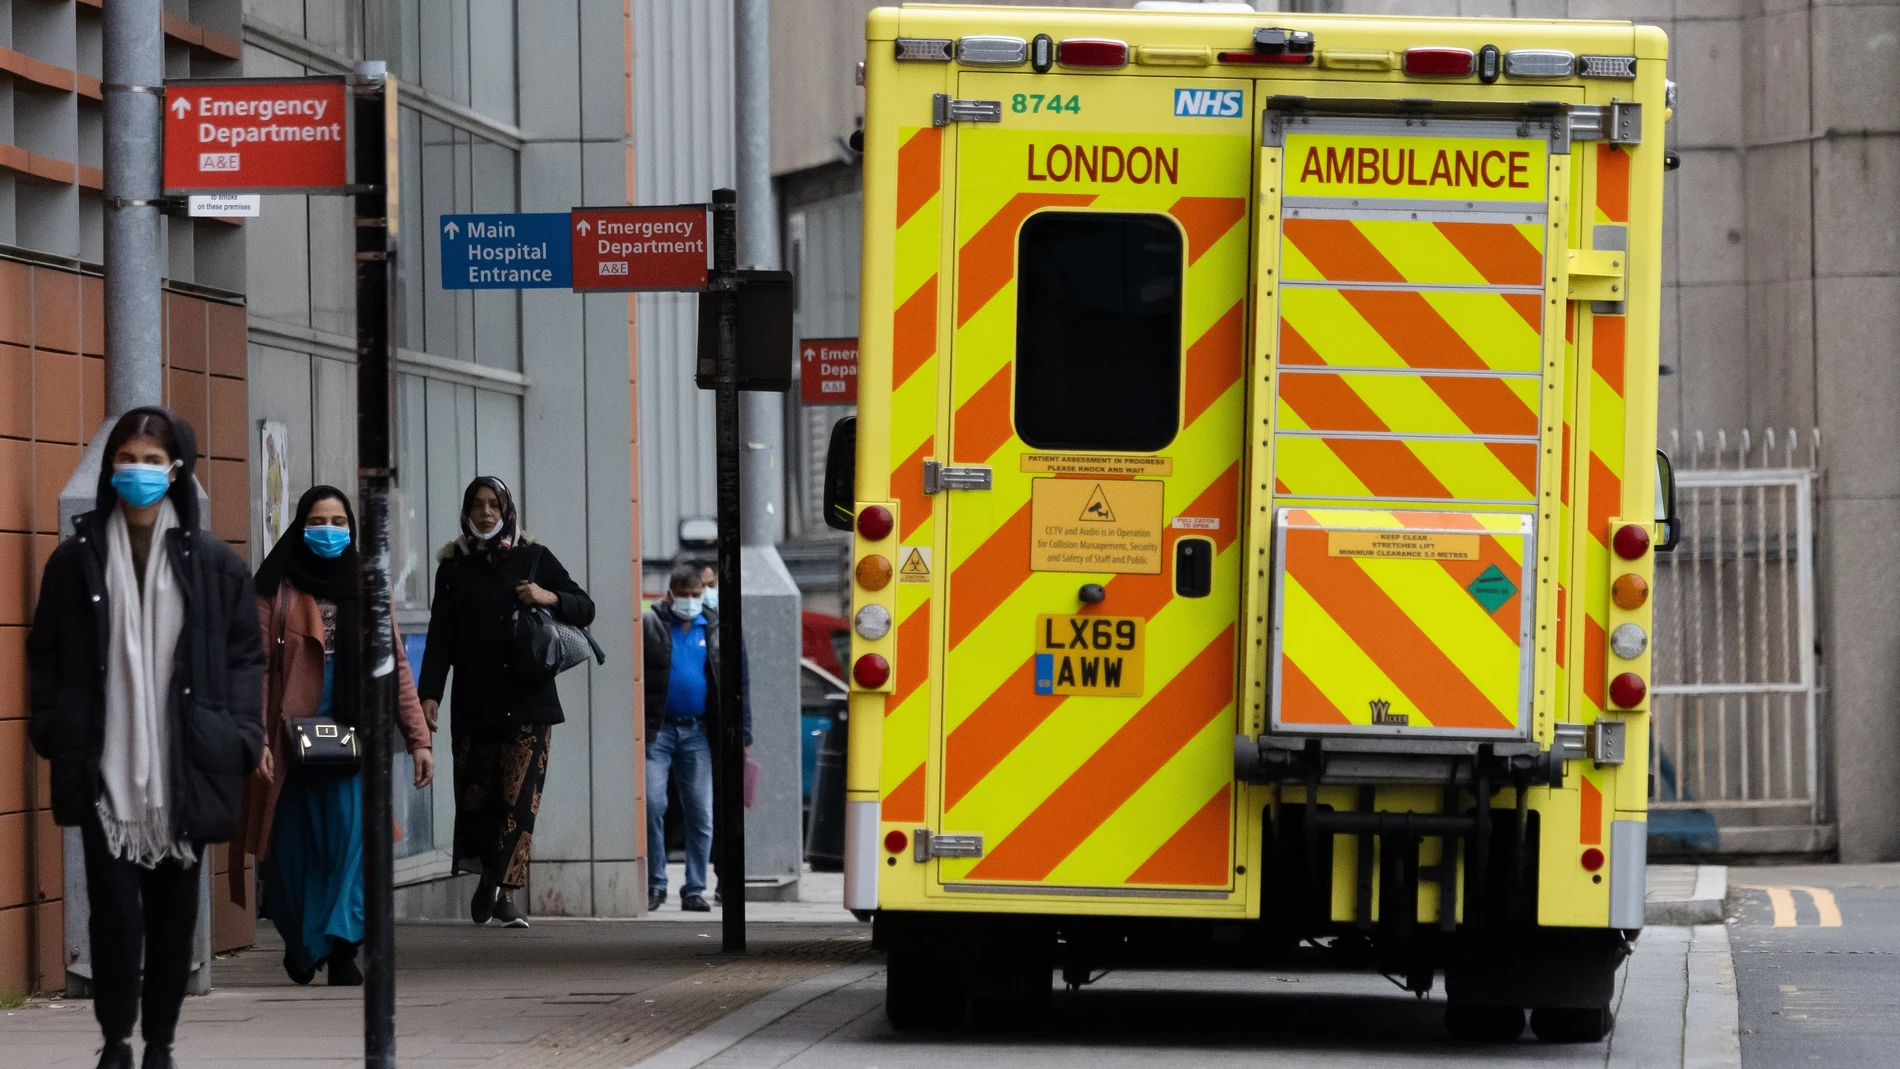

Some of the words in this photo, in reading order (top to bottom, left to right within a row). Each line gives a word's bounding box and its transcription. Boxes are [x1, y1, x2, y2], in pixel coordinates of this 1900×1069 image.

[200, 97, 328, 120] Emergency
[1012, 93, 1081, 114] 8744
[1175, 90, 1241, 116] NHS
[200, 122, 341, 147] Department
[203, 156, 238, 169] A&E
[1027, 143, 1179, 185] LONDON
[1300, 146, 1530, 189] AMBULANCE
[224, 203, 251, 211] premises
[468, 222, 515, 238] Main
[597, 220, 694, 237] Emergency
[468, 243, 547, 264] Hospital
[598, 239, 704, 257] Department
[469, 266, 552, 283] Entrance
[601, 263, 627, 274] A&E
[821, 347, 859, 361] Emer
[821, 363, 858, 378] Depa
[1061, 456, 1111, 464] ASSESSMENT
[1045, 526, 1063, 535] CCTV
[1064, 527, 1078, 536] and
[1080, 527, 1100, 536] Audio
[1101, 528, 1107, 536] is
[1108, 528, 1115, 537] in
[1116, 529, 1151, 538] Operation
[1038, 539, 1048, 547] for
[1049, 539, 1078, 548] Collision
[1130, 542, 1158, 553] Security
[1047, 554, 1060, 562] and
[1062, 554, 1084, 565] Safety
[1085, 555, 1093, 563] of
[1094, 555, 1111, 564] Staff
[1112, 555, 1125, 564] and
[1127, 556, 1147, 565] Public
[1046, 618, 1135, 650] LX69
[1057, 656, 1123, 688] AWW
